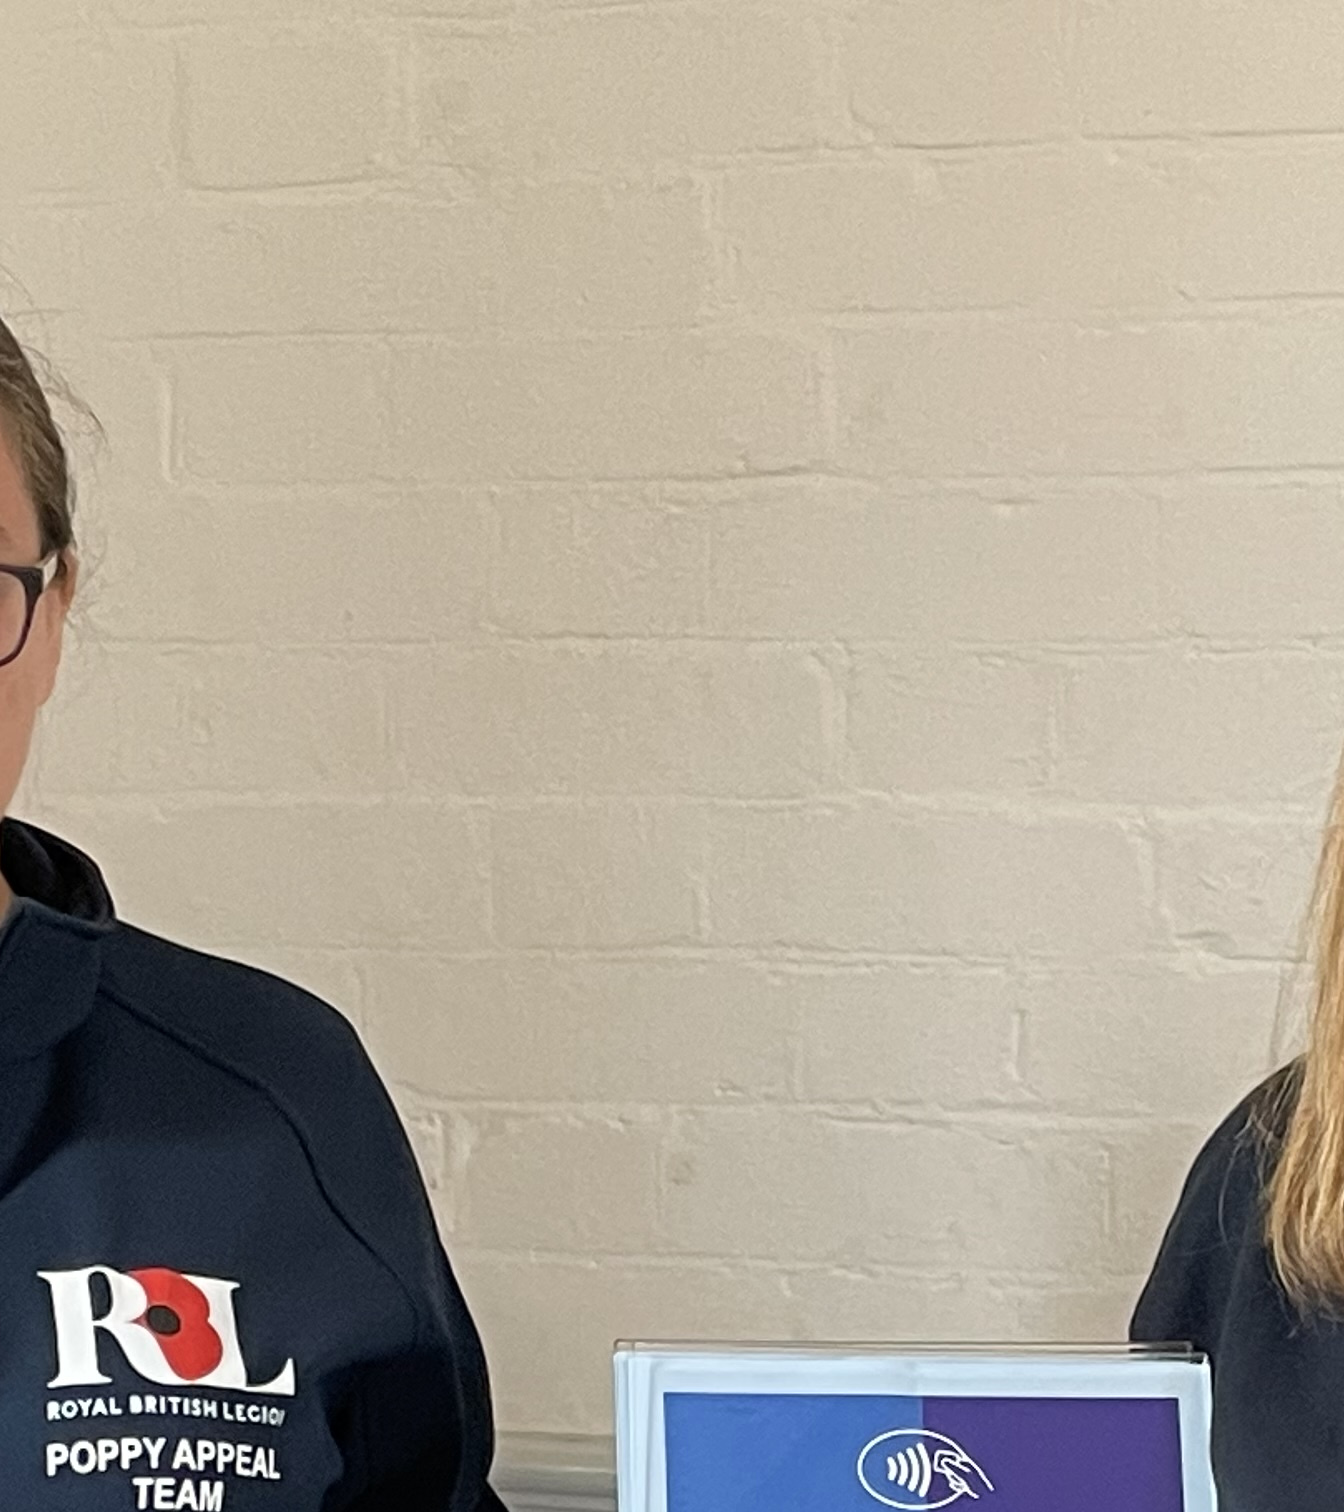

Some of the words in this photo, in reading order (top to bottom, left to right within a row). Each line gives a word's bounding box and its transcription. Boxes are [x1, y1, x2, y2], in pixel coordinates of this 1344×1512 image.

[46, 1397, 123, 1421] ROYAL
[129, 1395, 218, 1419] BRITISH
[46, 1437, 167, 1477] POPPY
[171, 1438, 281, 1480] APPEAL
[132, 1477, 225, 1512] TEAM
